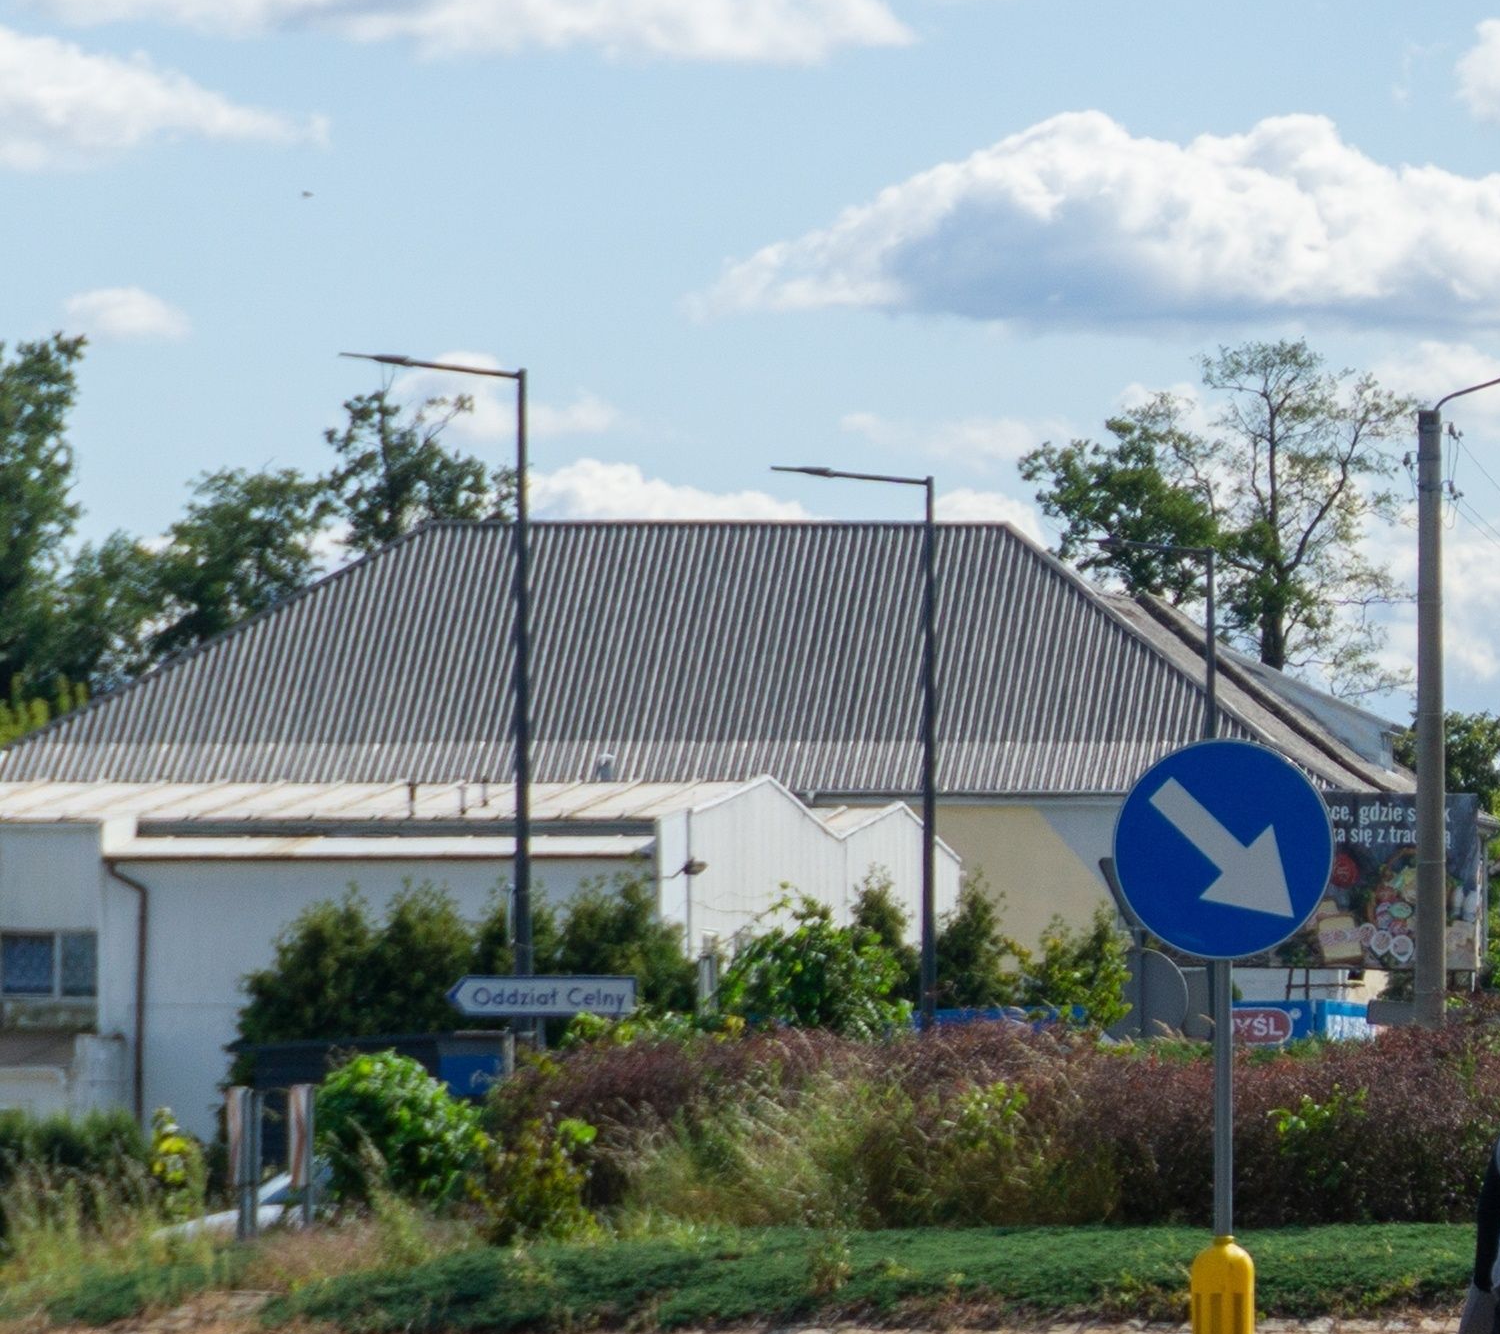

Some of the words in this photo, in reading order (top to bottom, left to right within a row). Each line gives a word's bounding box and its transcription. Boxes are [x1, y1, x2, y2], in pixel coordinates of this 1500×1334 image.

[1359, 801, 1403, 826] gdzie
[1350, 827, 1373, 848] się
[1376, 828, 1386, 843] z
[472, 986, 559, 1007] Oddział
[567, 986, 627, 1012] Celny
